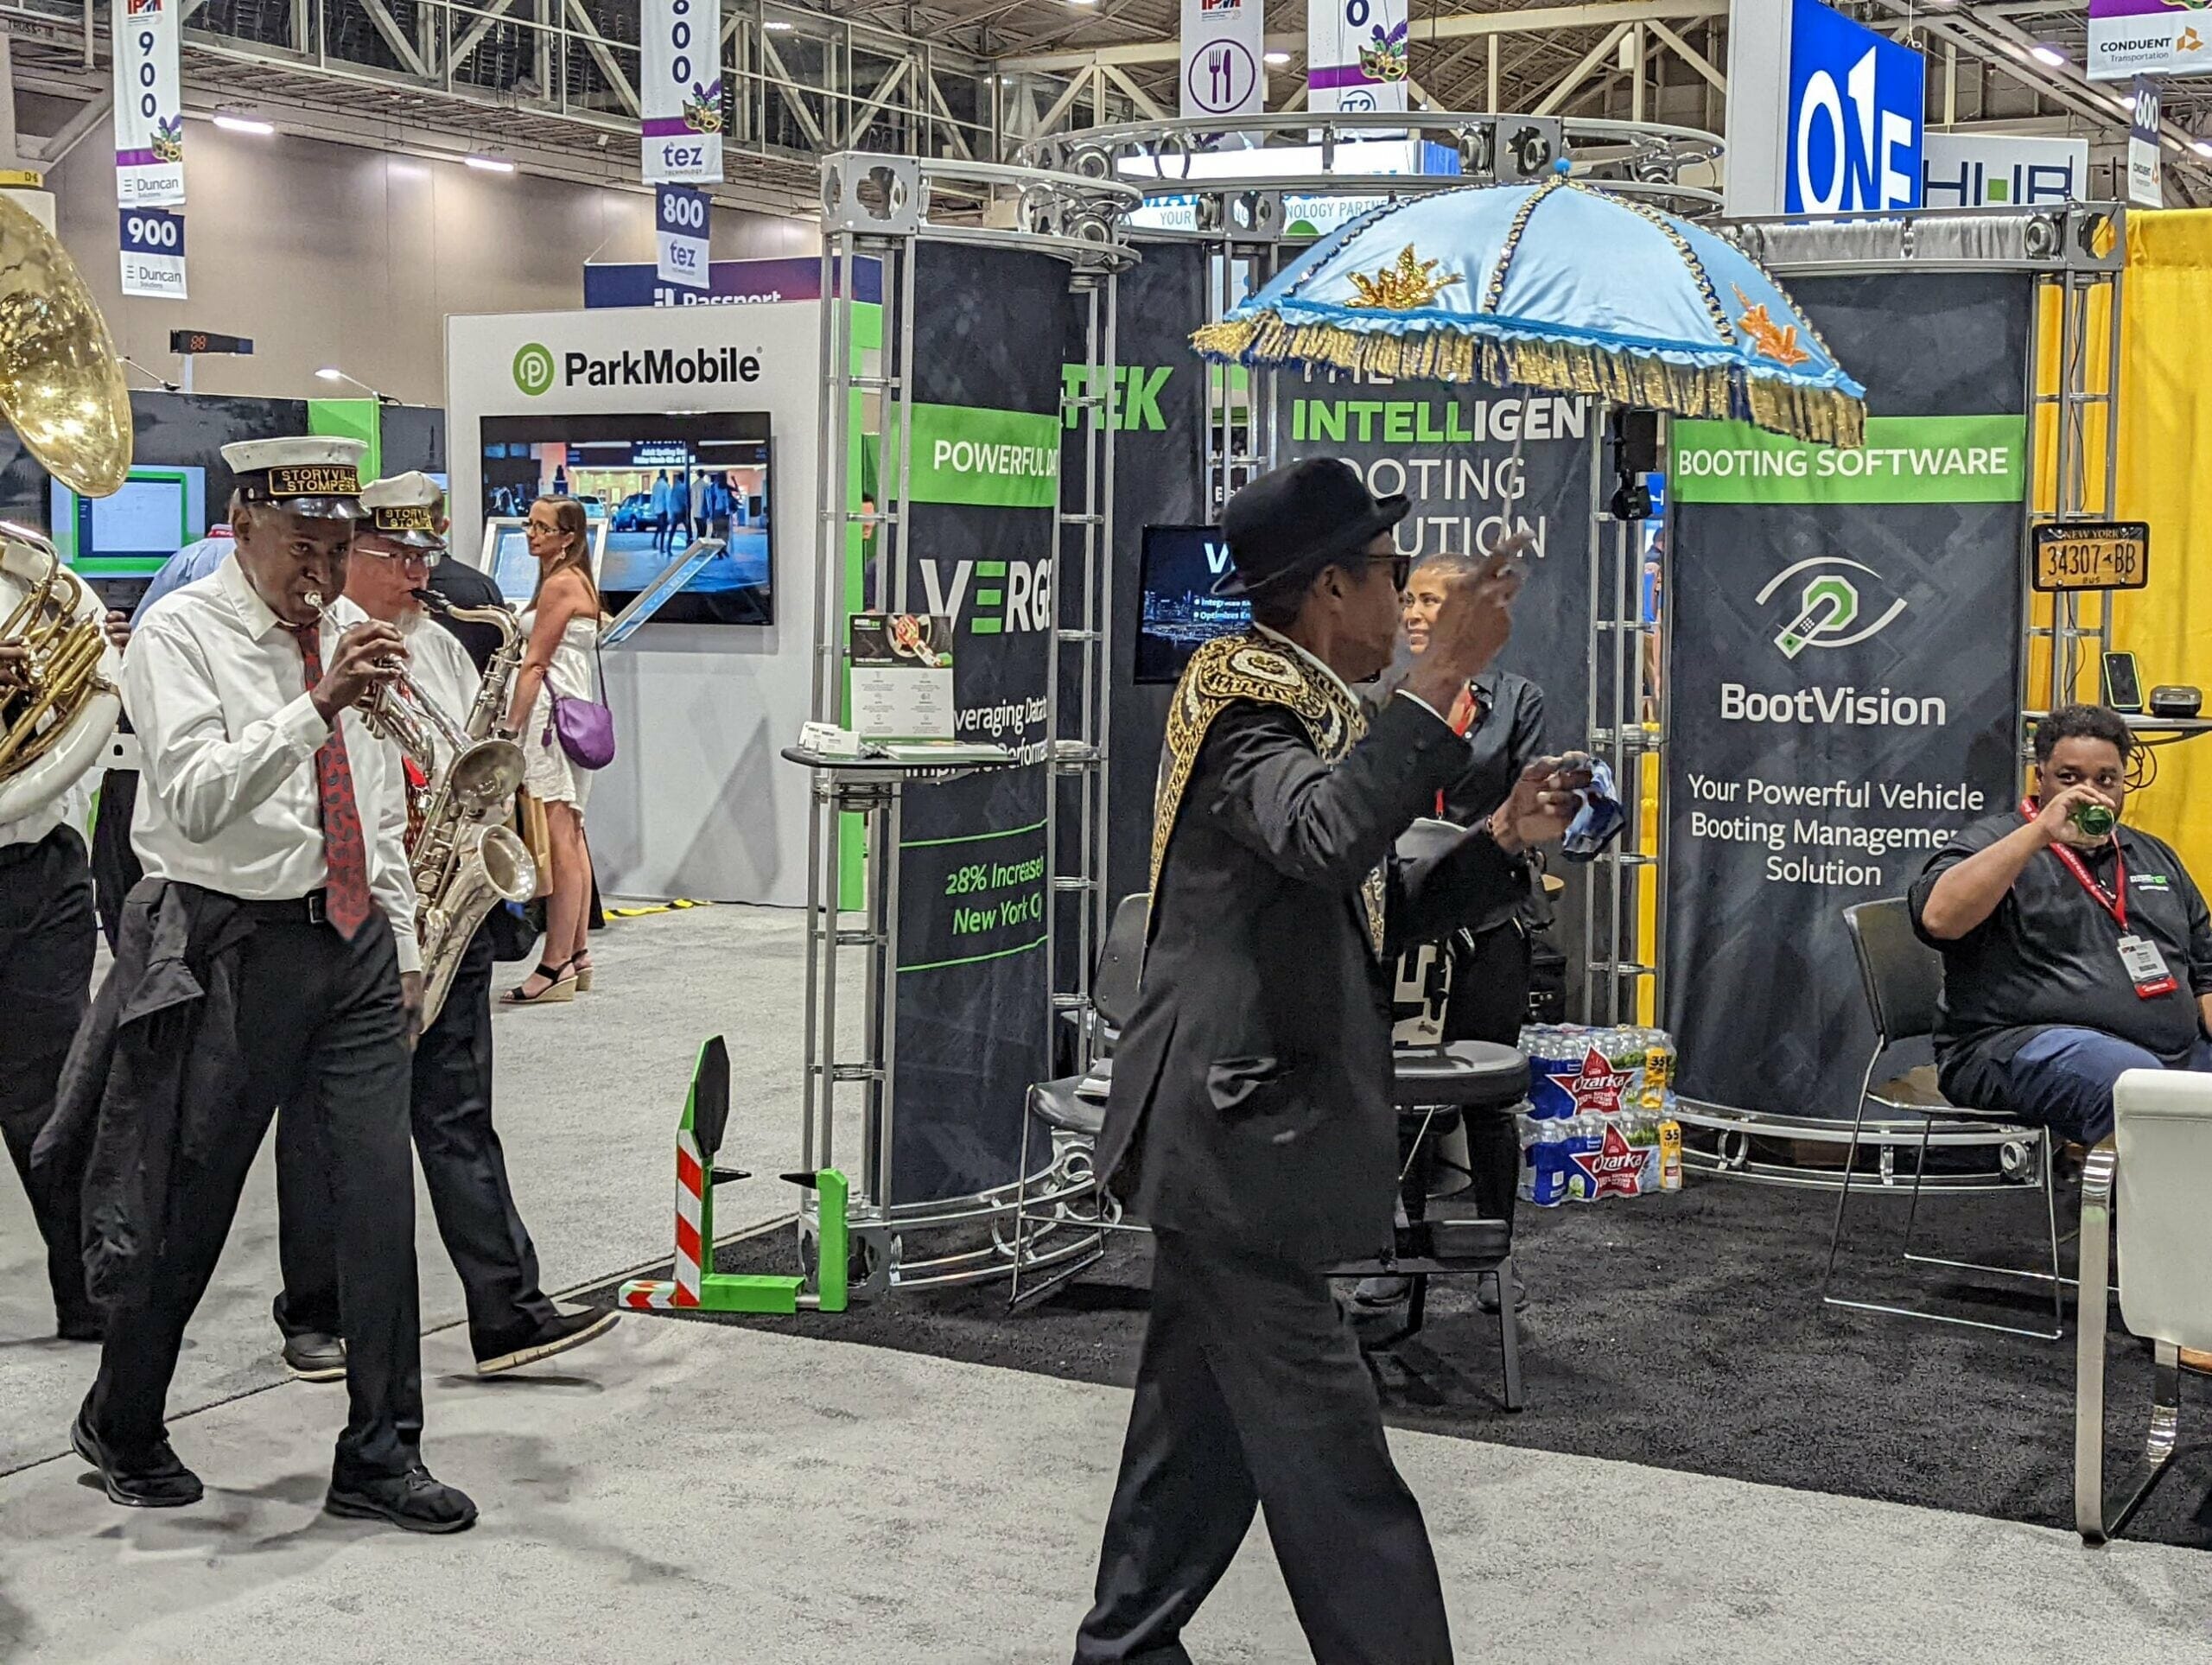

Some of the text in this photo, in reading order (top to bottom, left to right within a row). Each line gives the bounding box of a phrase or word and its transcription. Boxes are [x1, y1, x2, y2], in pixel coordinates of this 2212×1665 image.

[2101, 37, 2171, 52] CONDUENT
[2111, 52, 2169, 62] Transportation
[2135, 90, 2158, 132] 600
[1797, 46, 1912, 223] ONE
[662, 142, 702, 167] tez
[137, 179, 179, 191] Duncan
[663, 194, 703, 228] 800
[1160, 211, 1192, 226] YOUR
[1287, 203, 1333, 218] NOLOGY
[127, 217, 177, 247] 900
[670, 242, 696, 268] tez
[139, 266, 181, 283] Duncan
[566, 346, 760, 386] ParkMobile
[934, 440, 1045, 477] POWERFUL
[1679, 448, 2008, 477] BOOTING SOFTWARE
[1393, 516, 1546, 558] UTION
[2063, 527, 2121, 539] NEW YORK
[954, 698, 1026, 737] veraging
[1720, 683, 1946, 726] BootVision
[1688, 774, 1985, 810] Your Powerful Vehicle
[1691, 811, 1958, 855] Booting Manageme
[945, 863, 987, 894] 28%
[1766, 855, 1882, 886] Solution
[953, 908, 997, 935] New
[1001, 895, 1028, 926] York
[1572, 1074, 1624, 1092] Ozarka
[1664, 1129, 1679, 1141] 35
[1592, 1152, 1642, 1173] Ozarka
